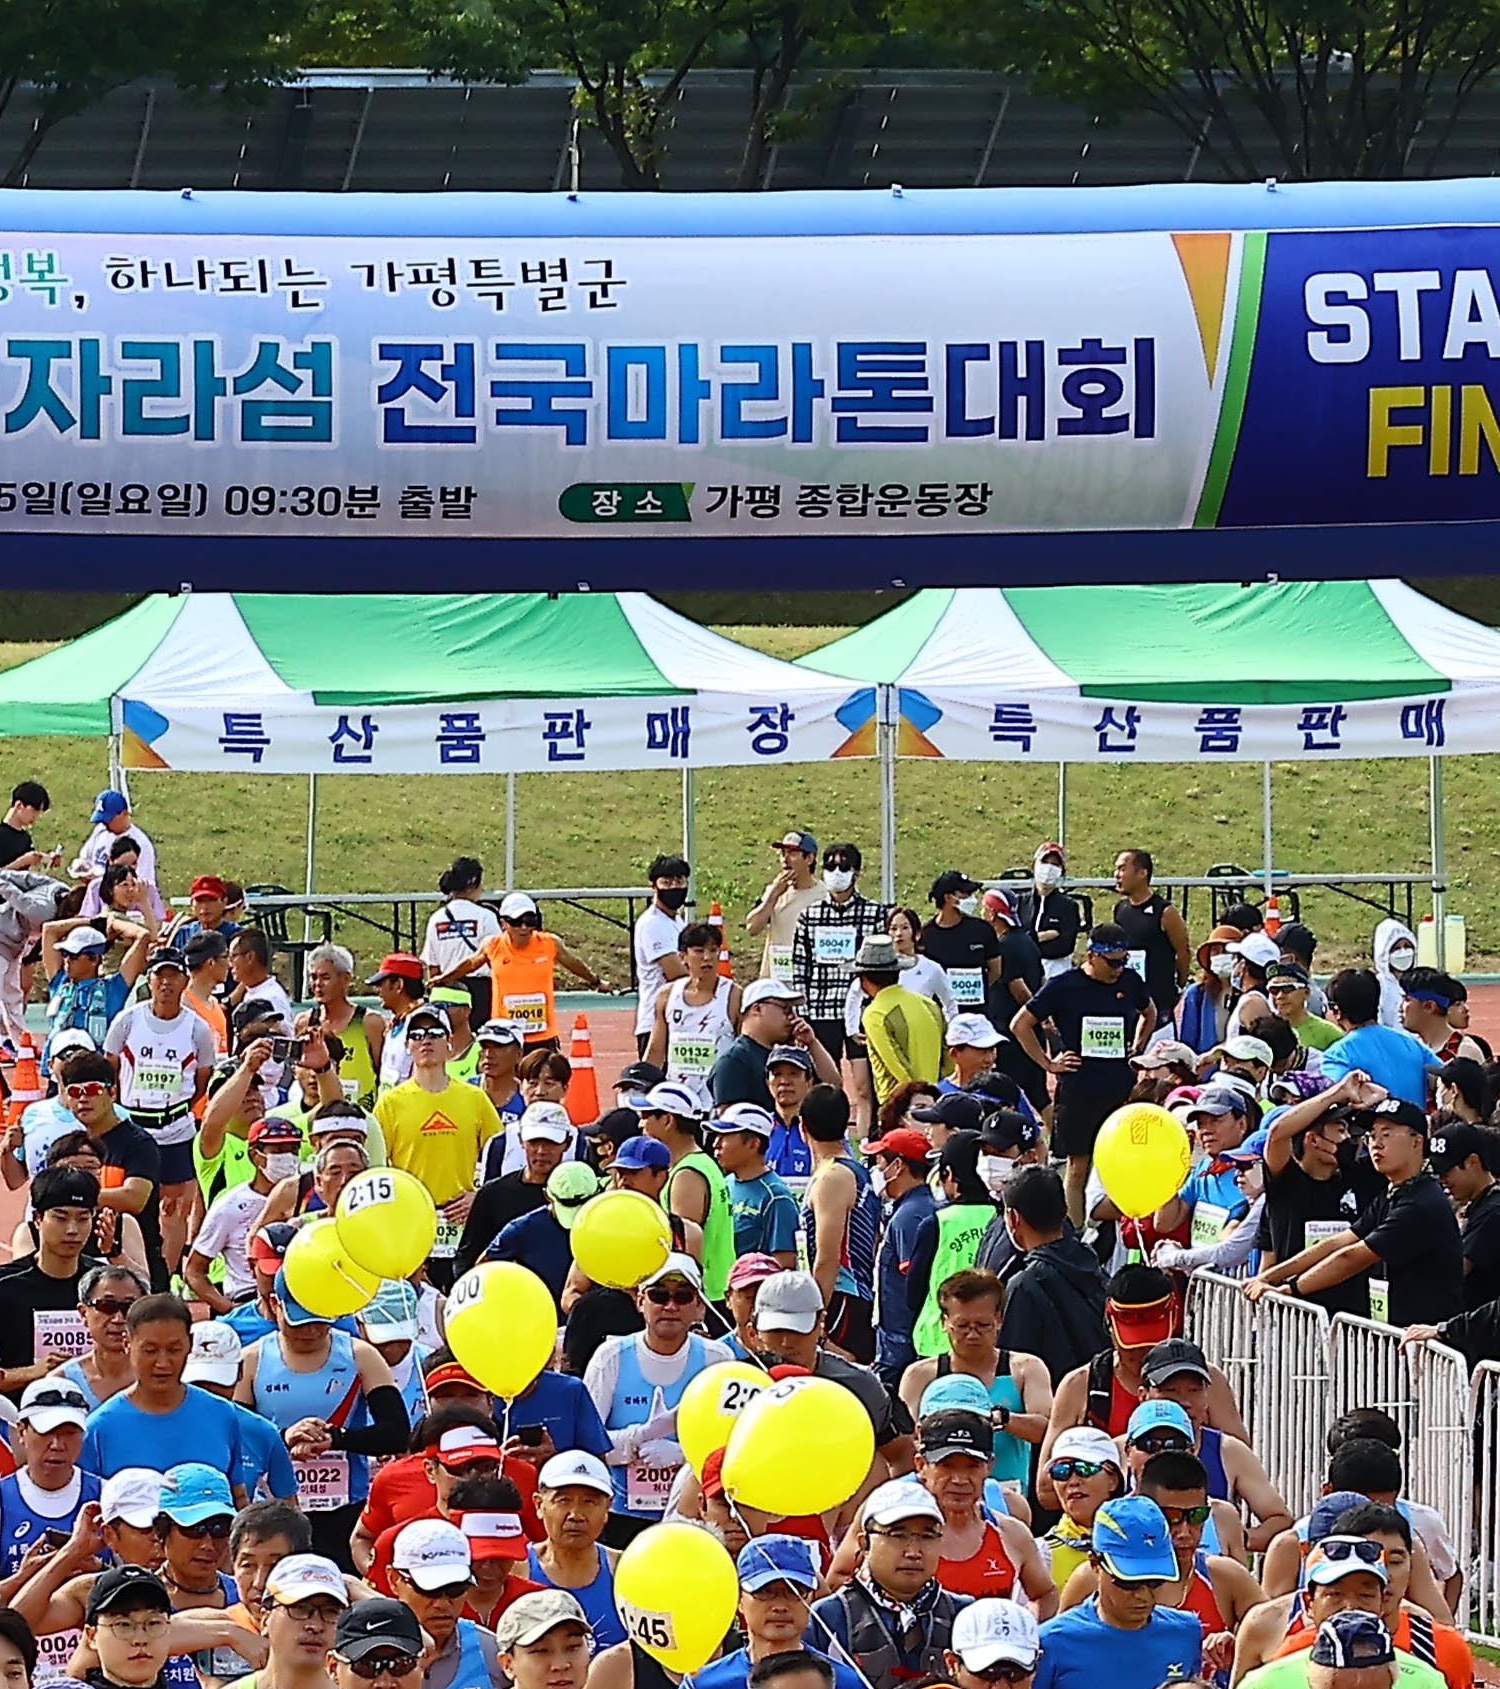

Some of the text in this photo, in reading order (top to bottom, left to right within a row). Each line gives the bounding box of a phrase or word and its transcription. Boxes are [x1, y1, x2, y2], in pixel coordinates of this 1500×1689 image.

[105, 257, 327, 308] 하나되는
[350, 257, 627, 313] 가평특별군
[377, 337, 1156, 447] 전국마라톤대회
[224, 485, 381, 519] 09:30분
[398, 485, 478, 520] 출발
[705, 484, 781, 519] 가평
[795, 482, 994, 518] 종합운동장
